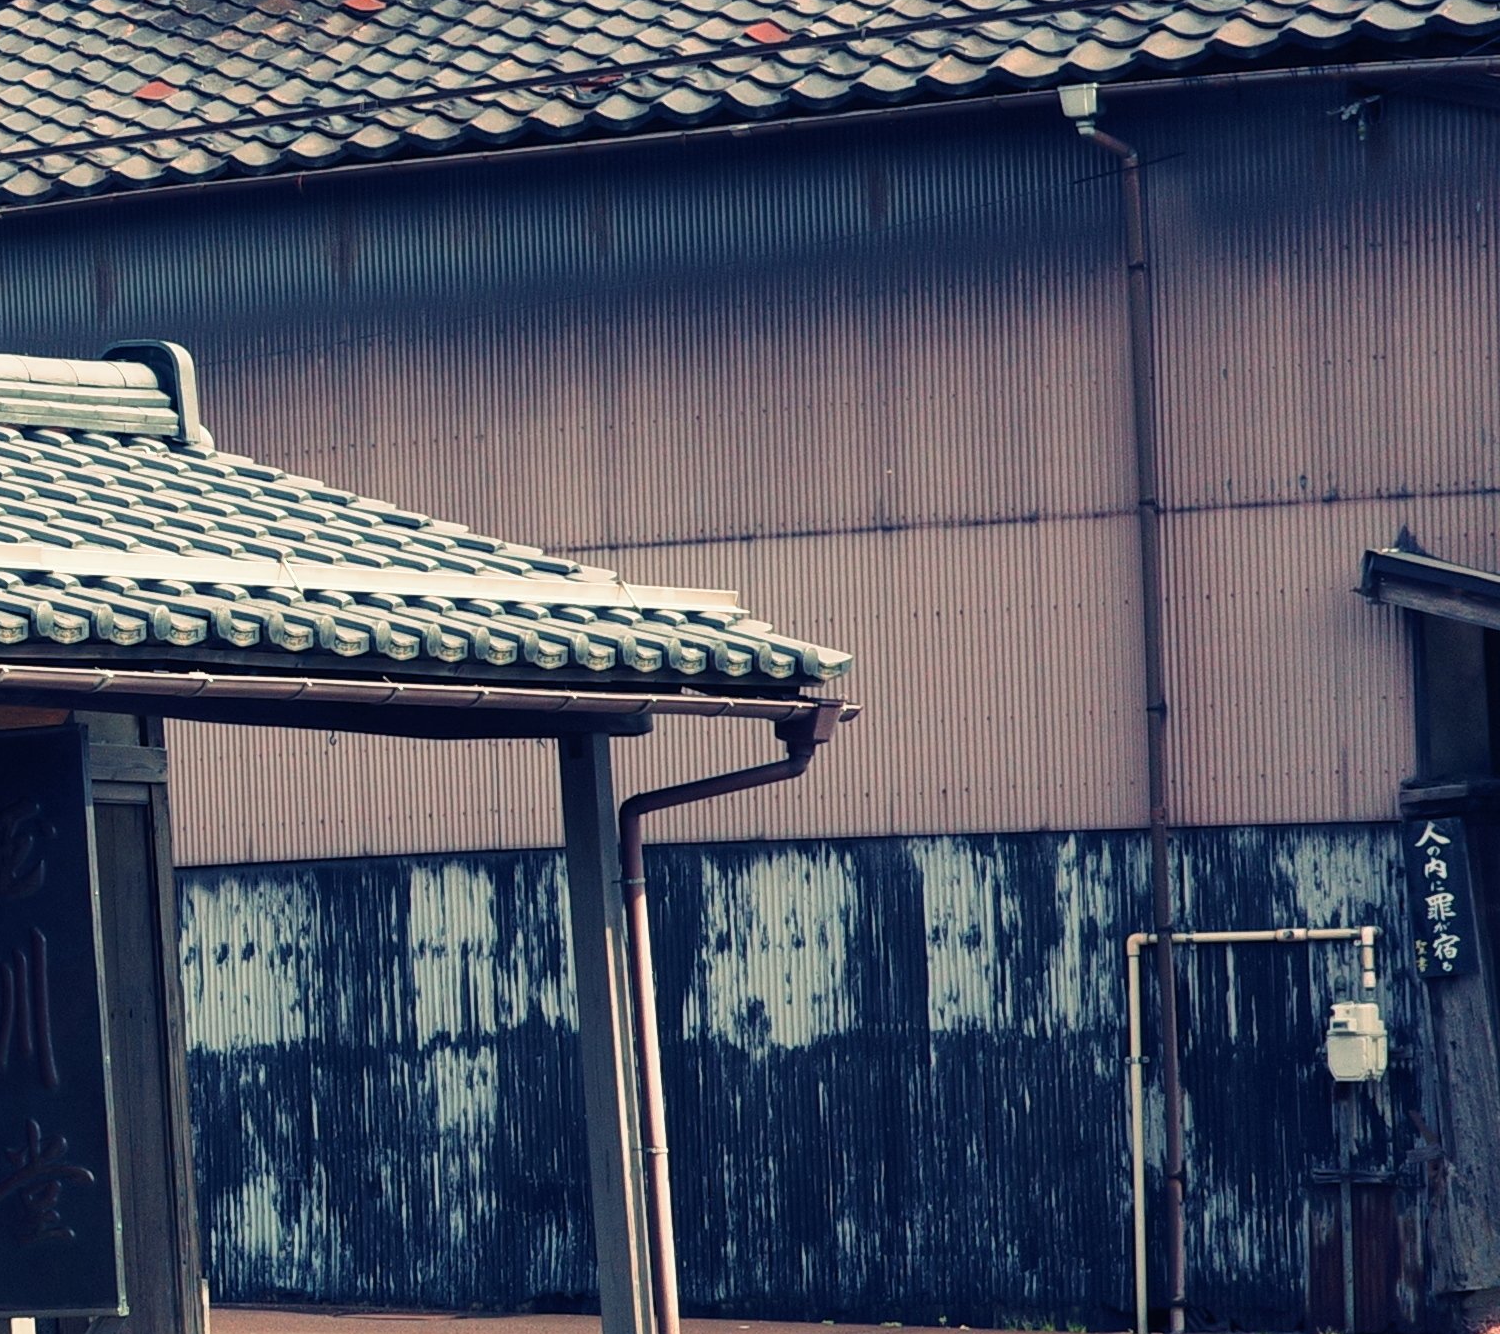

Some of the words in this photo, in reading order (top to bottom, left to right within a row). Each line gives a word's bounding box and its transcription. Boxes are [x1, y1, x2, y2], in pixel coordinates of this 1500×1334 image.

[1414, 820, 1461, 972] 人の内に罪が宿る
[1414, 939, 1429, 973] 聖書
